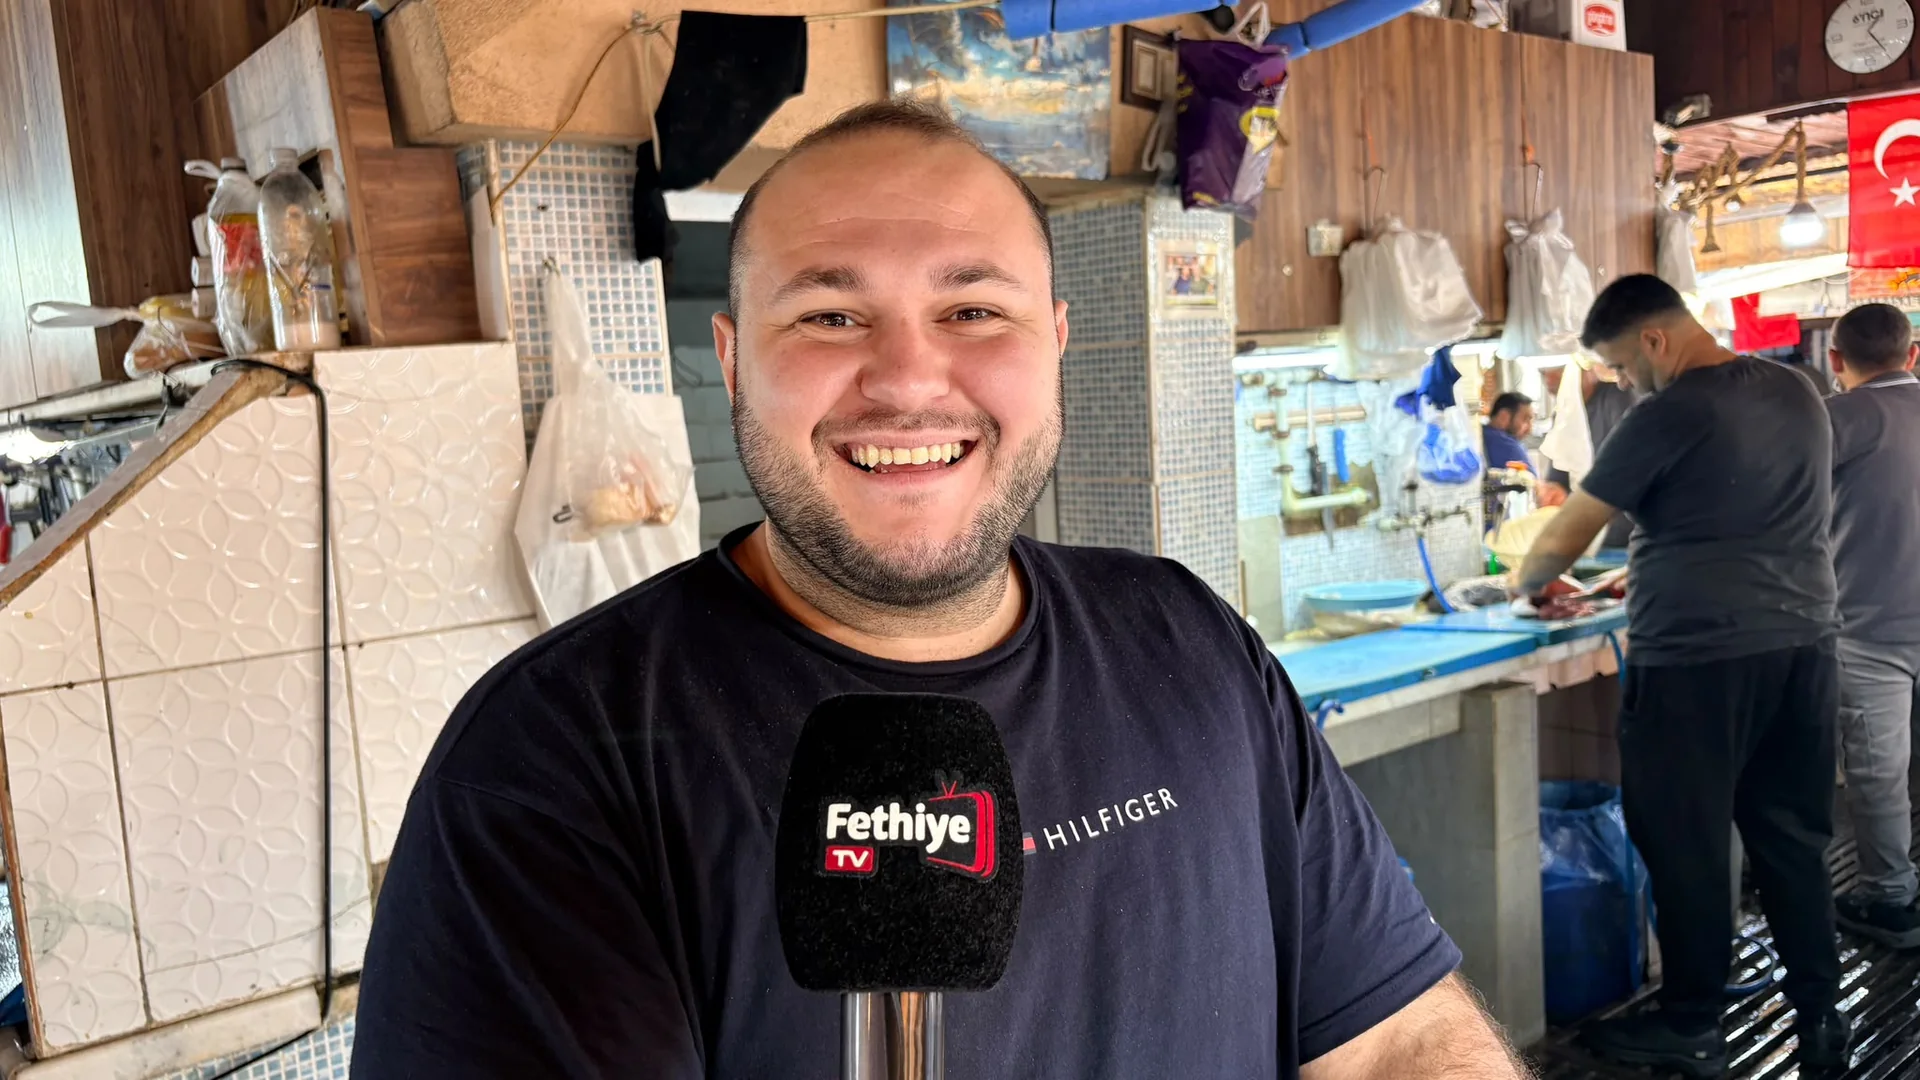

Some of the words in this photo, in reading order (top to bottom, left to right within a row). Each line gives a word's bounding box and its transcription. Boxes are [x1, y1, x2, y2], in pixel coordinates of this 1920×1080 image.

[826, 803, 970, 854] Fethiye
[1042, 787, 1178, 850] HILFIGER
[832, 850, 869, 868] TV
